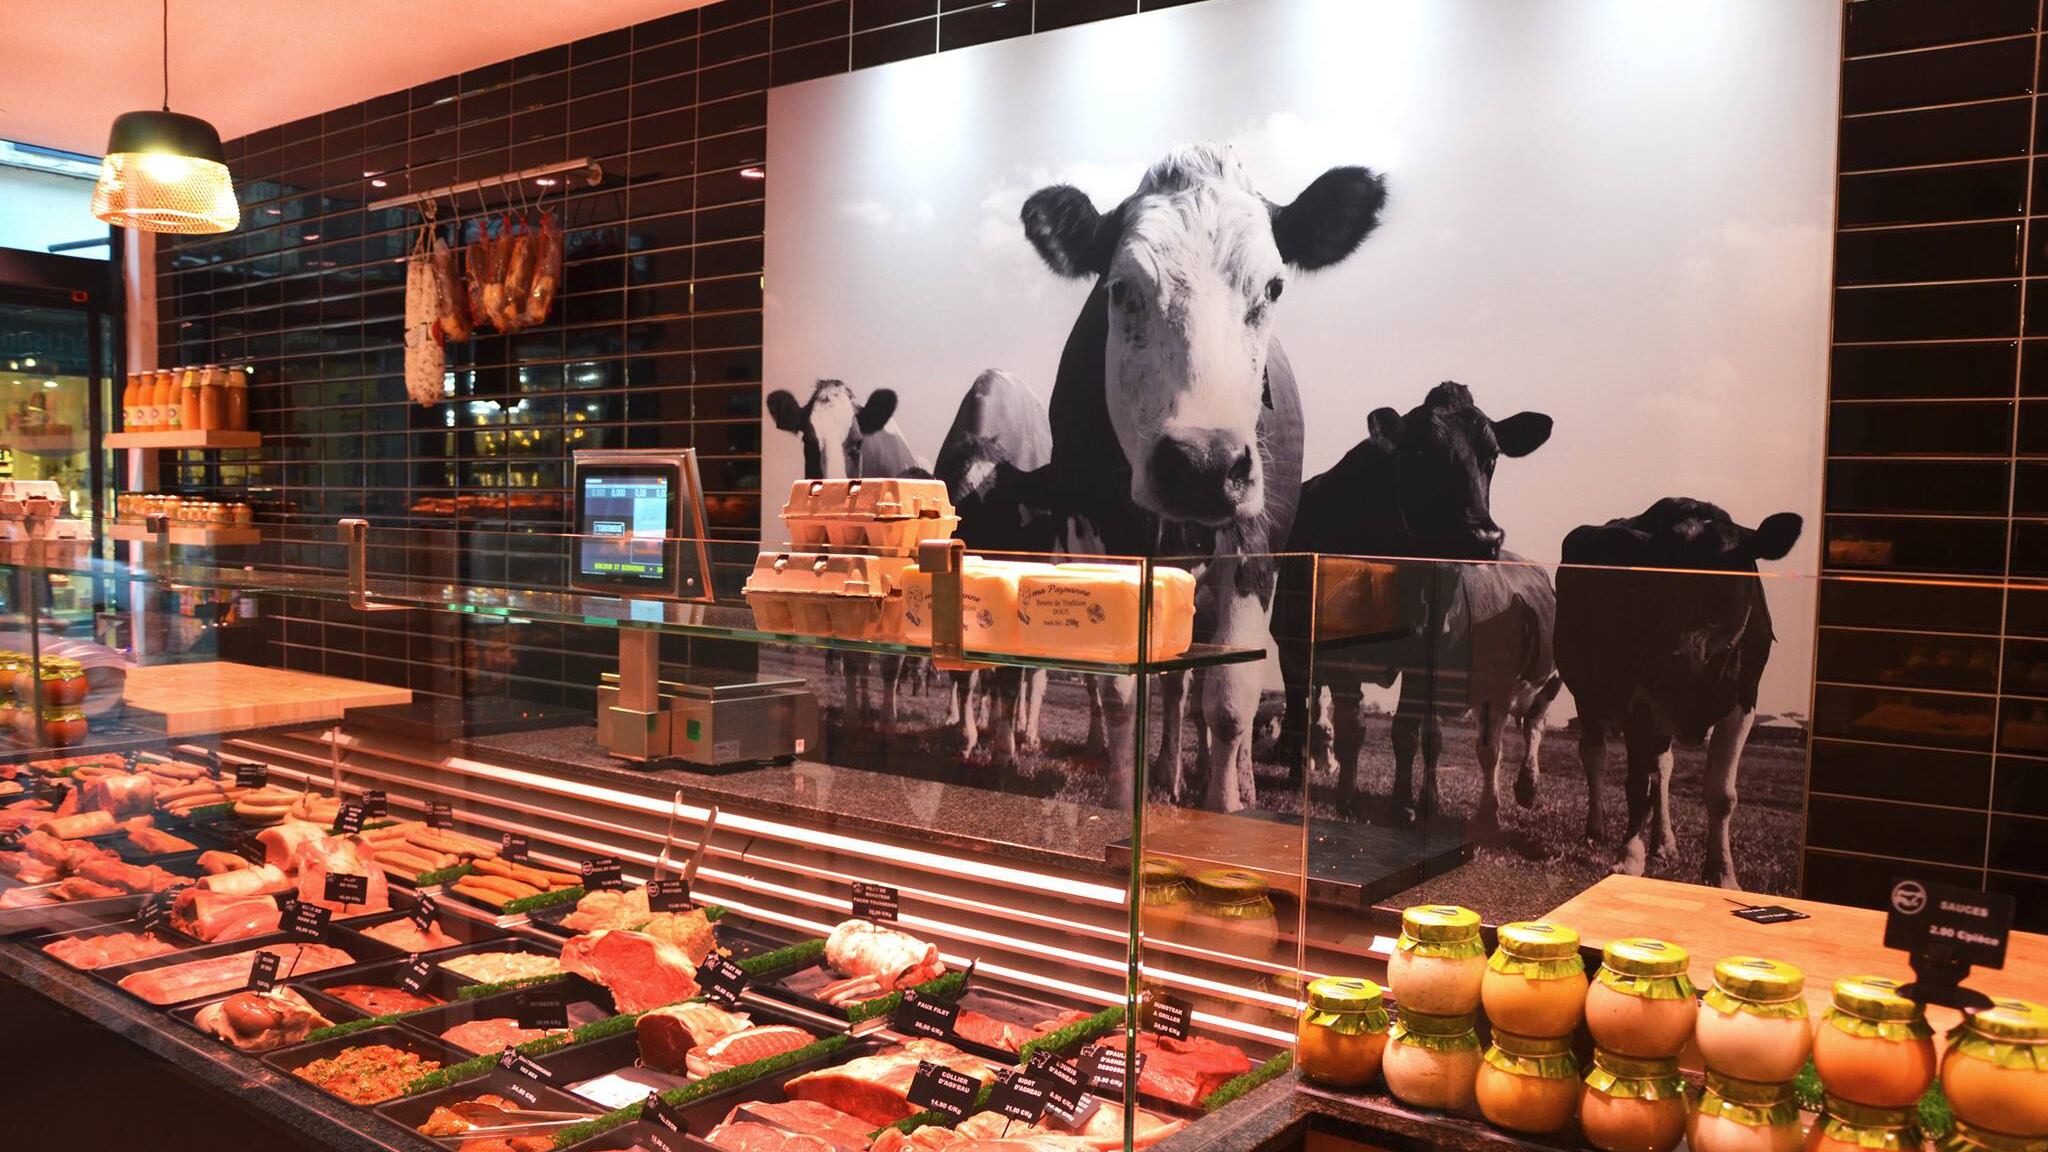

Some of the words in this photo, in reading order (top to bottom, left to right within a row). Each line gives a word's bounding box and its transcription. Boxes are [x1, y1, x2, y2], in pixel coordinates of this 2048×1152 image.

[1939, 901, 1989, 917] SAUCES
[722, 961, 736, 972] FILET
[734, 968, 742, 976] DE
[917, 1001, 933, 1011] FAUX
[933, 1006, 950, 1017] FILET
[1158, 1011, 1181, 1023] GRILLER
[1048, 1066, 1077, 1085] D'AGNEAU
[1055, 1061, 1077, 1076] SOURIS
[941, 1071, 968, 1085] COLLIER
[1017, 1077, 1036, 1087] GIGOT
[938, 1078, 970, 1094] D'AGNEAU
[1013, 1085, 1042, 1097] D'AGNEAU
[930, 1099, 948, 1110] 14.90
